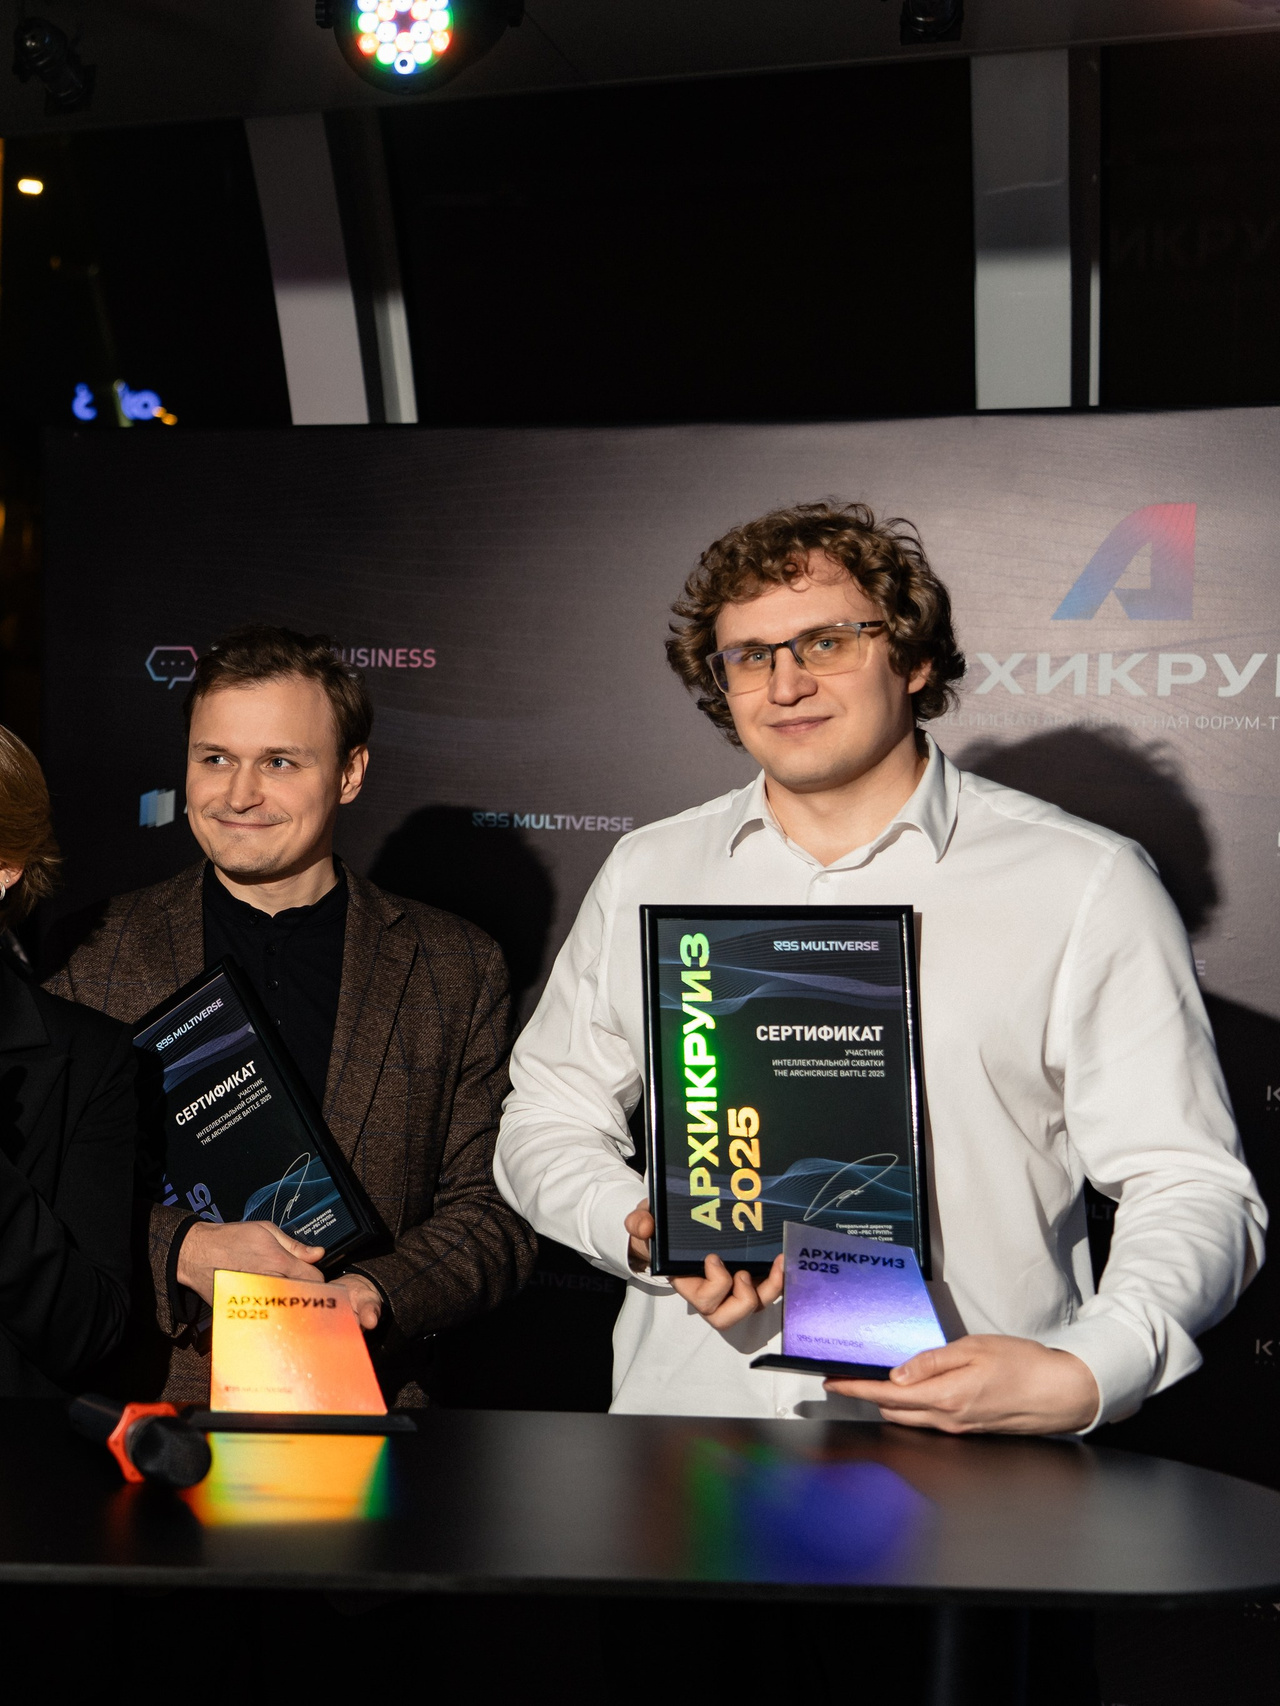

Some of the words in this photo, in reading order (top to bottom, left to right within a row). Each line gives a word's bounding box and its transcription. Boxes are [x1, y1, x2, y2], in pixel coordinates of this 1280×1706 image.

[973, 652, 1280, 697] ХИКРУ
[513, 813, 634, 832] MULTIVERSE
[801, 941, 880, 951] MULTIVERSE
[172, 998, 224, 1040] MULTIVERSE
[755, 1025, 884, 1042] СЕРТИФИКАТ
[844, 1049, 884, 1057] УЧАСТНИК
[772, 1059, 850, 1067] ИНТЕЛЛЕКТУАЛЬНОЙ
[679, 932, 722, 1231] АРХИКРУИЗ
[773, 1069, 788, 1077] THE
[789, 1069, 838, 1077] ARCHICRUISE
[175, 1060, 257, 1126] СЕРТИФИКАТ
[237, 1077, 264, 1098] УЧАСТНИК
[200, 1135, 212, 1146] THE
[242, 1102, 261, 1118] BATTLE
[727, 1106, 763, 1232] 2025
[798, 1260, 839, 1274] 2025
[799, 1248, 905, 1269] АРХИКРУИЗ
[228, 1296, 337, 1309] АРХИКРУИЗ
[227, 1309, 270, 1319] 2025
